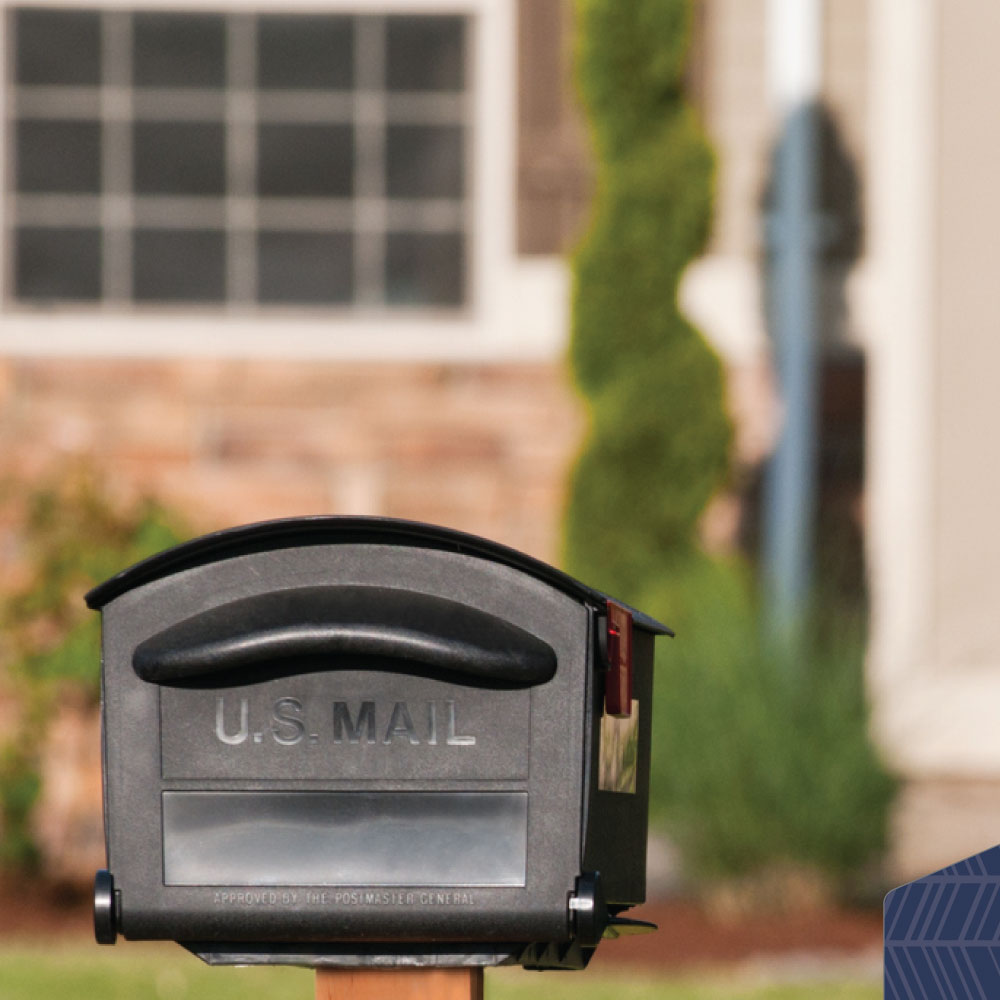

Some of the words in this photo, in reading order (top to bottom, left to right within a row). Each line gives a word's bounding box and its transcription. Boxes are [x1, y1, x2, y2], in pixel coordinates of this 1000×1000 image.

[215, 697, 318, 745] U.S.
[333, 701, 476, 746] MAIL
[213, 891, 277, 905] APPROVED
[282, 891, 298, 905] BY
[306, 891, 327, 905] THE
[334, 891, 414, 905] POSTMASTER
[420, 891, 474, 905] GENERAL
